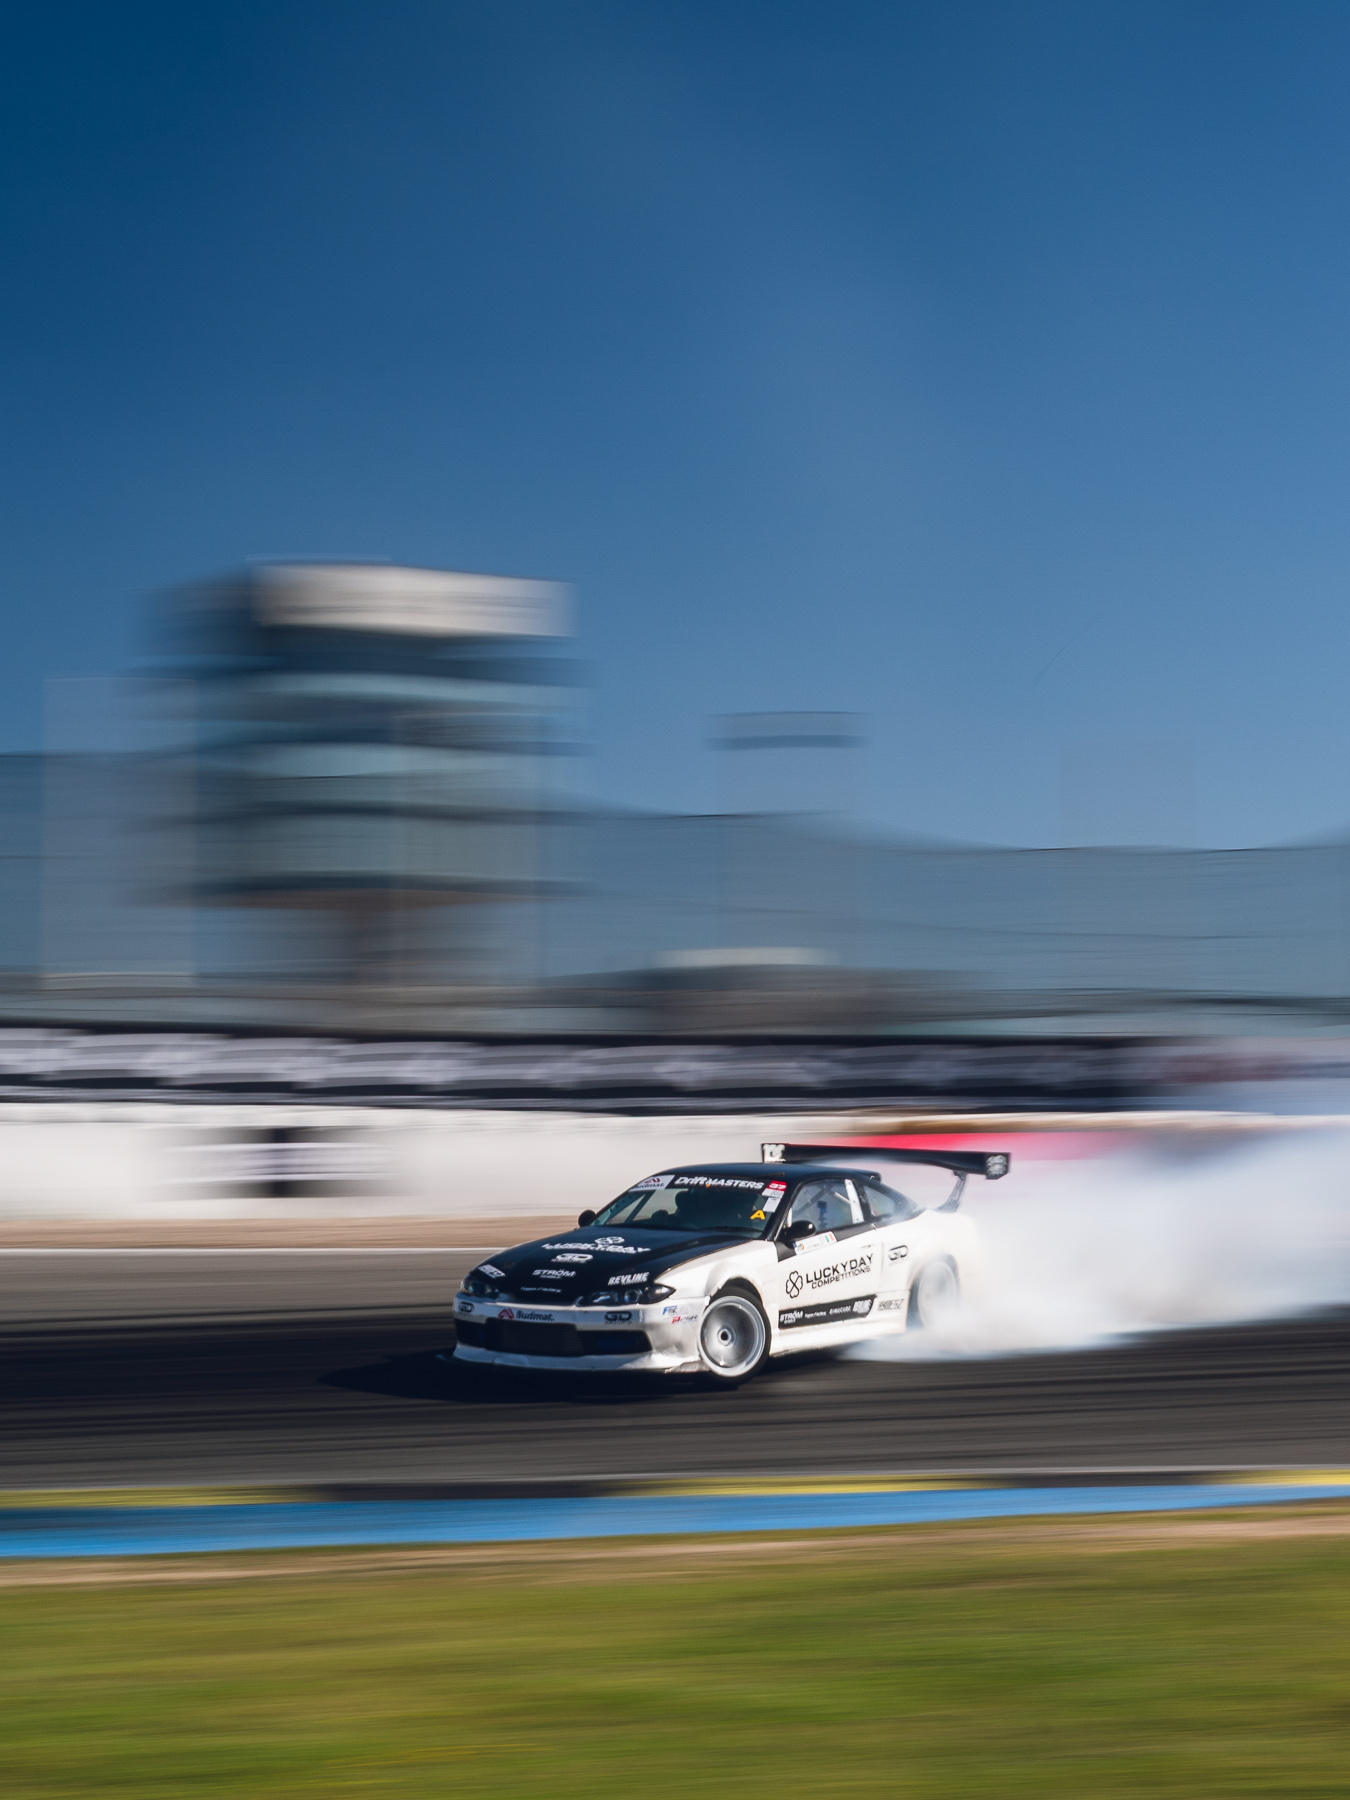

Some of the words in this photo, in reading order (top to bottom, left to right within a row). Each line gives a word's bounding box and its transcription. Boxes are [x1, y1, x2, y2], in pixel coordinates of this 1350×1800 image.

[674, 1176, 708, 1185] Drift
[706, 1178, 765, 1190] MASTERS
[750, 1210, 765, 1220] A
[805, 1253, 874, 1284] LUCKYDAY
[607, 1272, 650, 1286] REVLINE
[811, 1265, 871, 1290] COMPETITIONS
